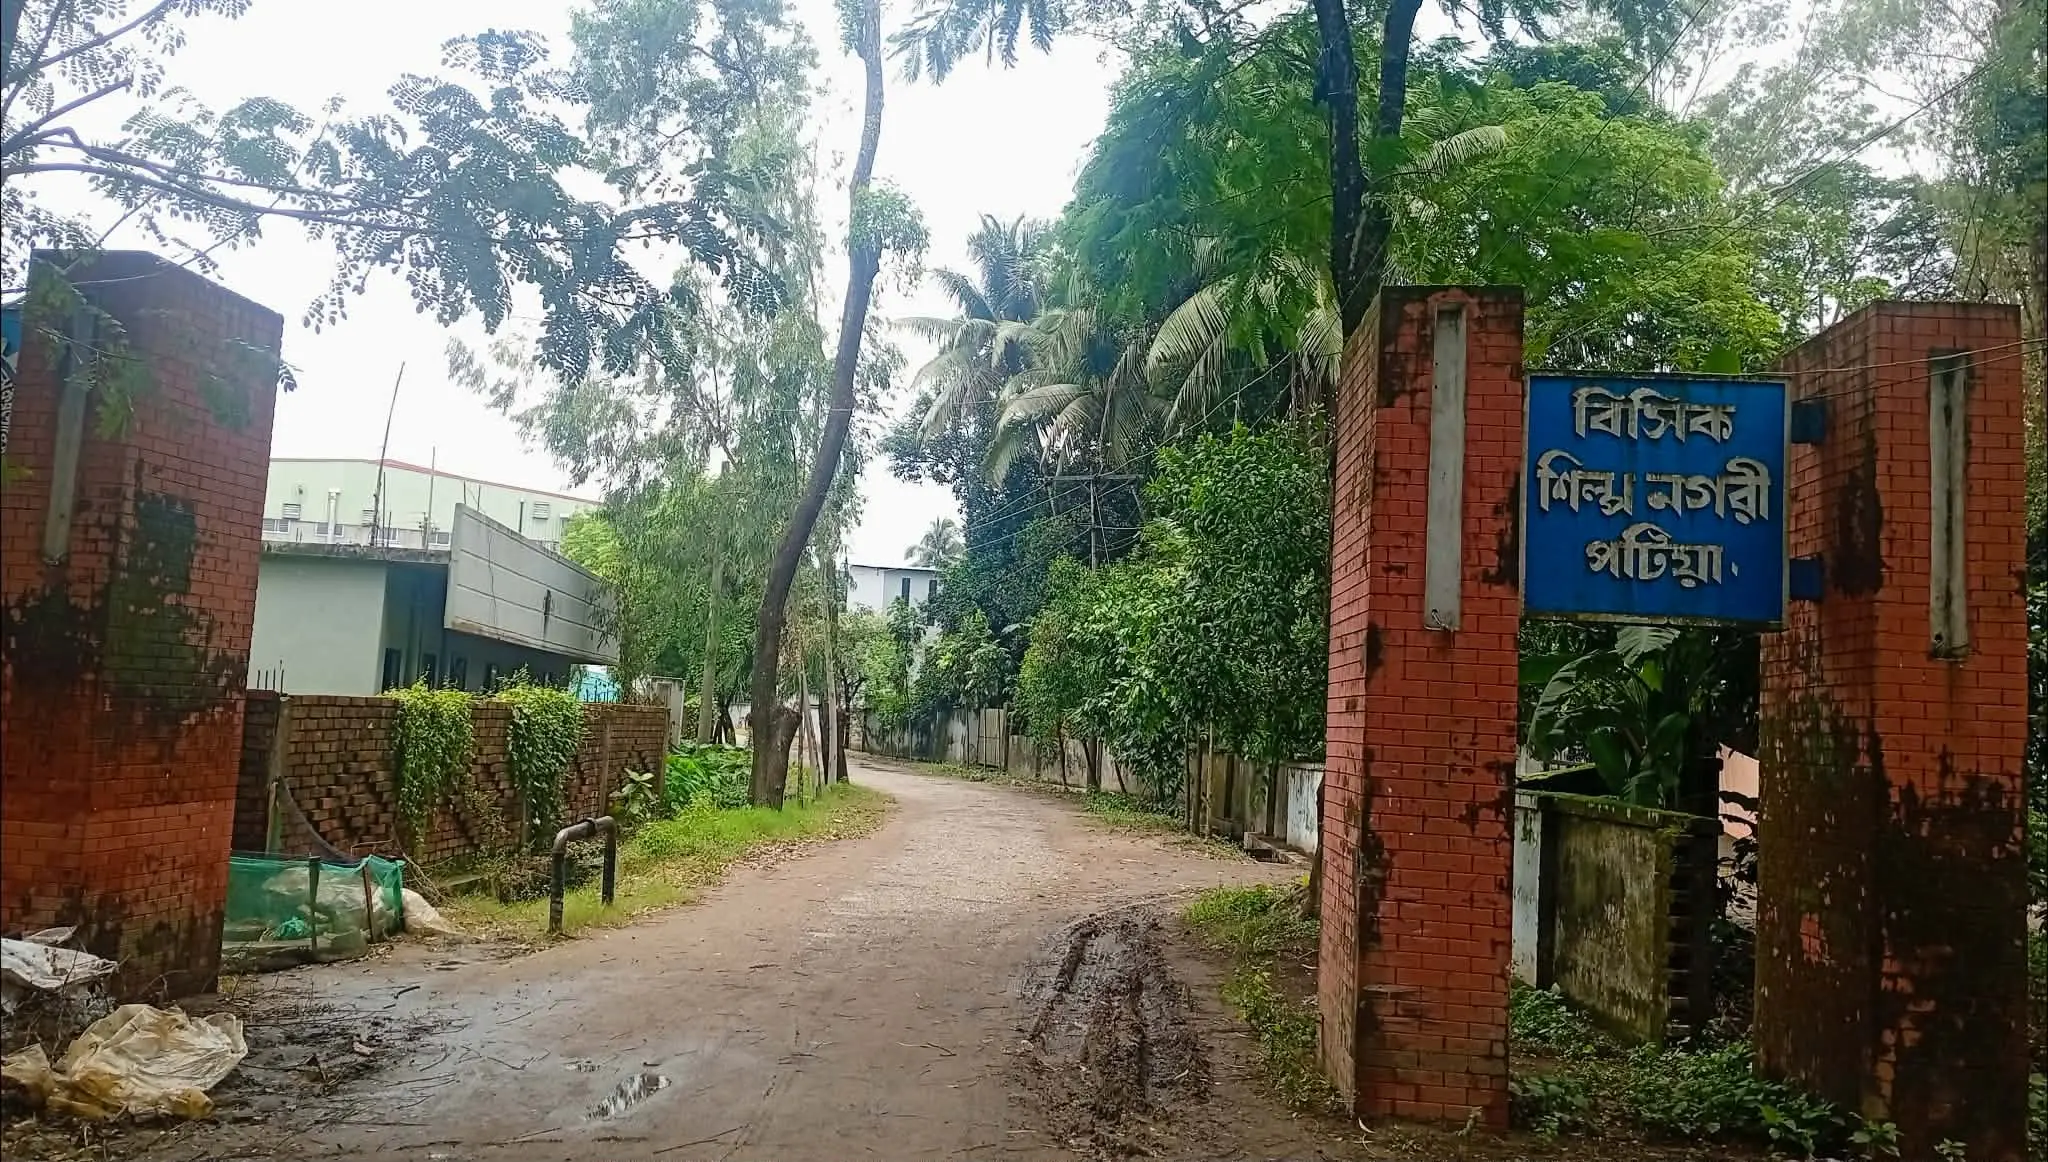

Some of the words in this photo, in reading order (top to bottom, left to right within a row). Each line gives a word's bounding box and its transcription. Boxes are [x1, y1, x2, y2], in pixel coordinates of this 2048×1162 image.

[1573, 388, 1737, 443] বিসিক
[1537, 450, 1636, 516] শিল্প
[1646, 457, 1772, 525] নগরী
